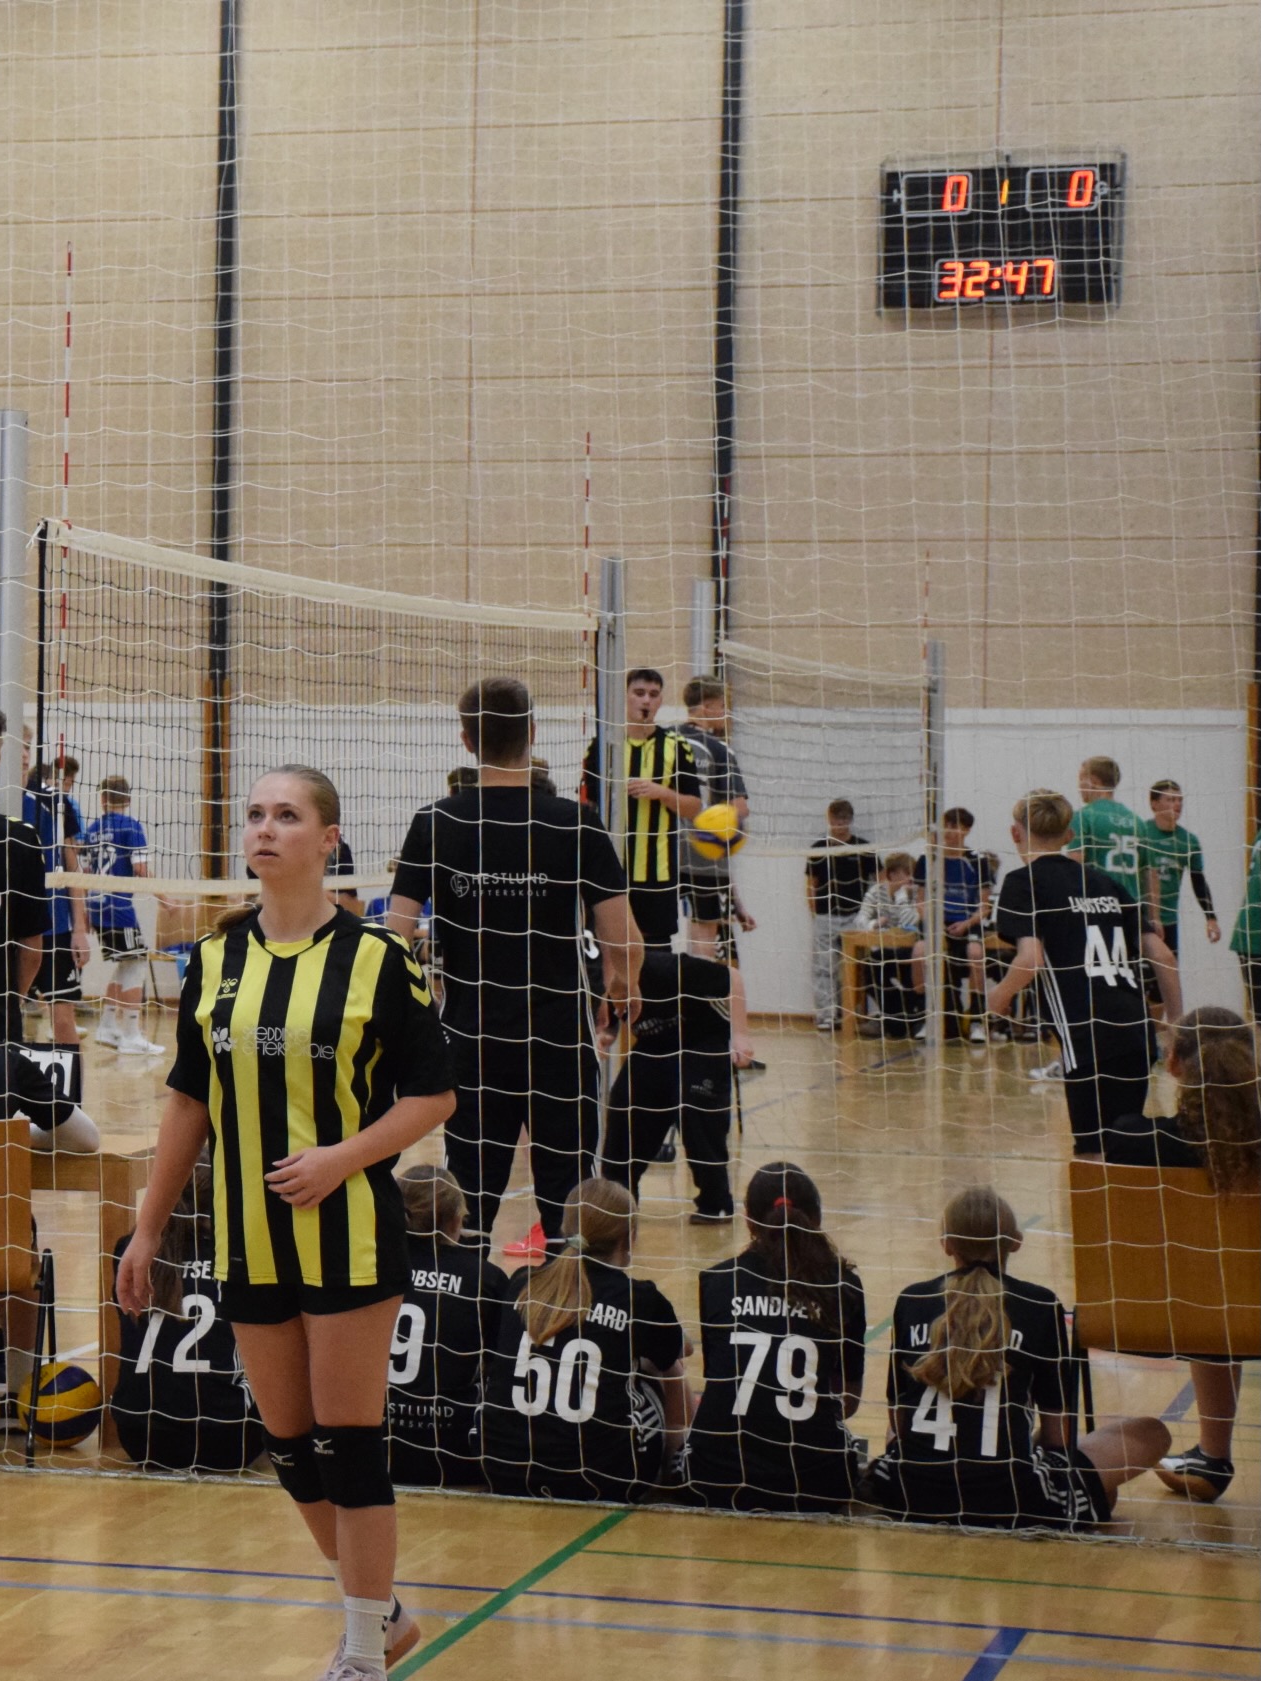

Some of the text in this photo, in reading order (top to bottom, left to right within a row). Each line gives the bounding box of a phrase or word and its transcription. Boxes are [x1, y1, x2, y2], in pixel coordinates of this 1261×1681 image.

[942, 174, 969, 212] 0
[1066, 169, 1094, 207] 0
[939, 258, 1056, 299] 32:47
[471, 872, 549, 885] HESTLUND
[472, 889, 548, 897] EFTERSKOLE
[1084, 924, 1138, 989] 44
[182, 1260, 215, 1280] TSE
[585, 1302, 628, 1333] ARD
[511, 1330, 603, 1423] 50
[729, 1331, 820, 1421] 79
[387, 1402, 455, 1418] STLUND
